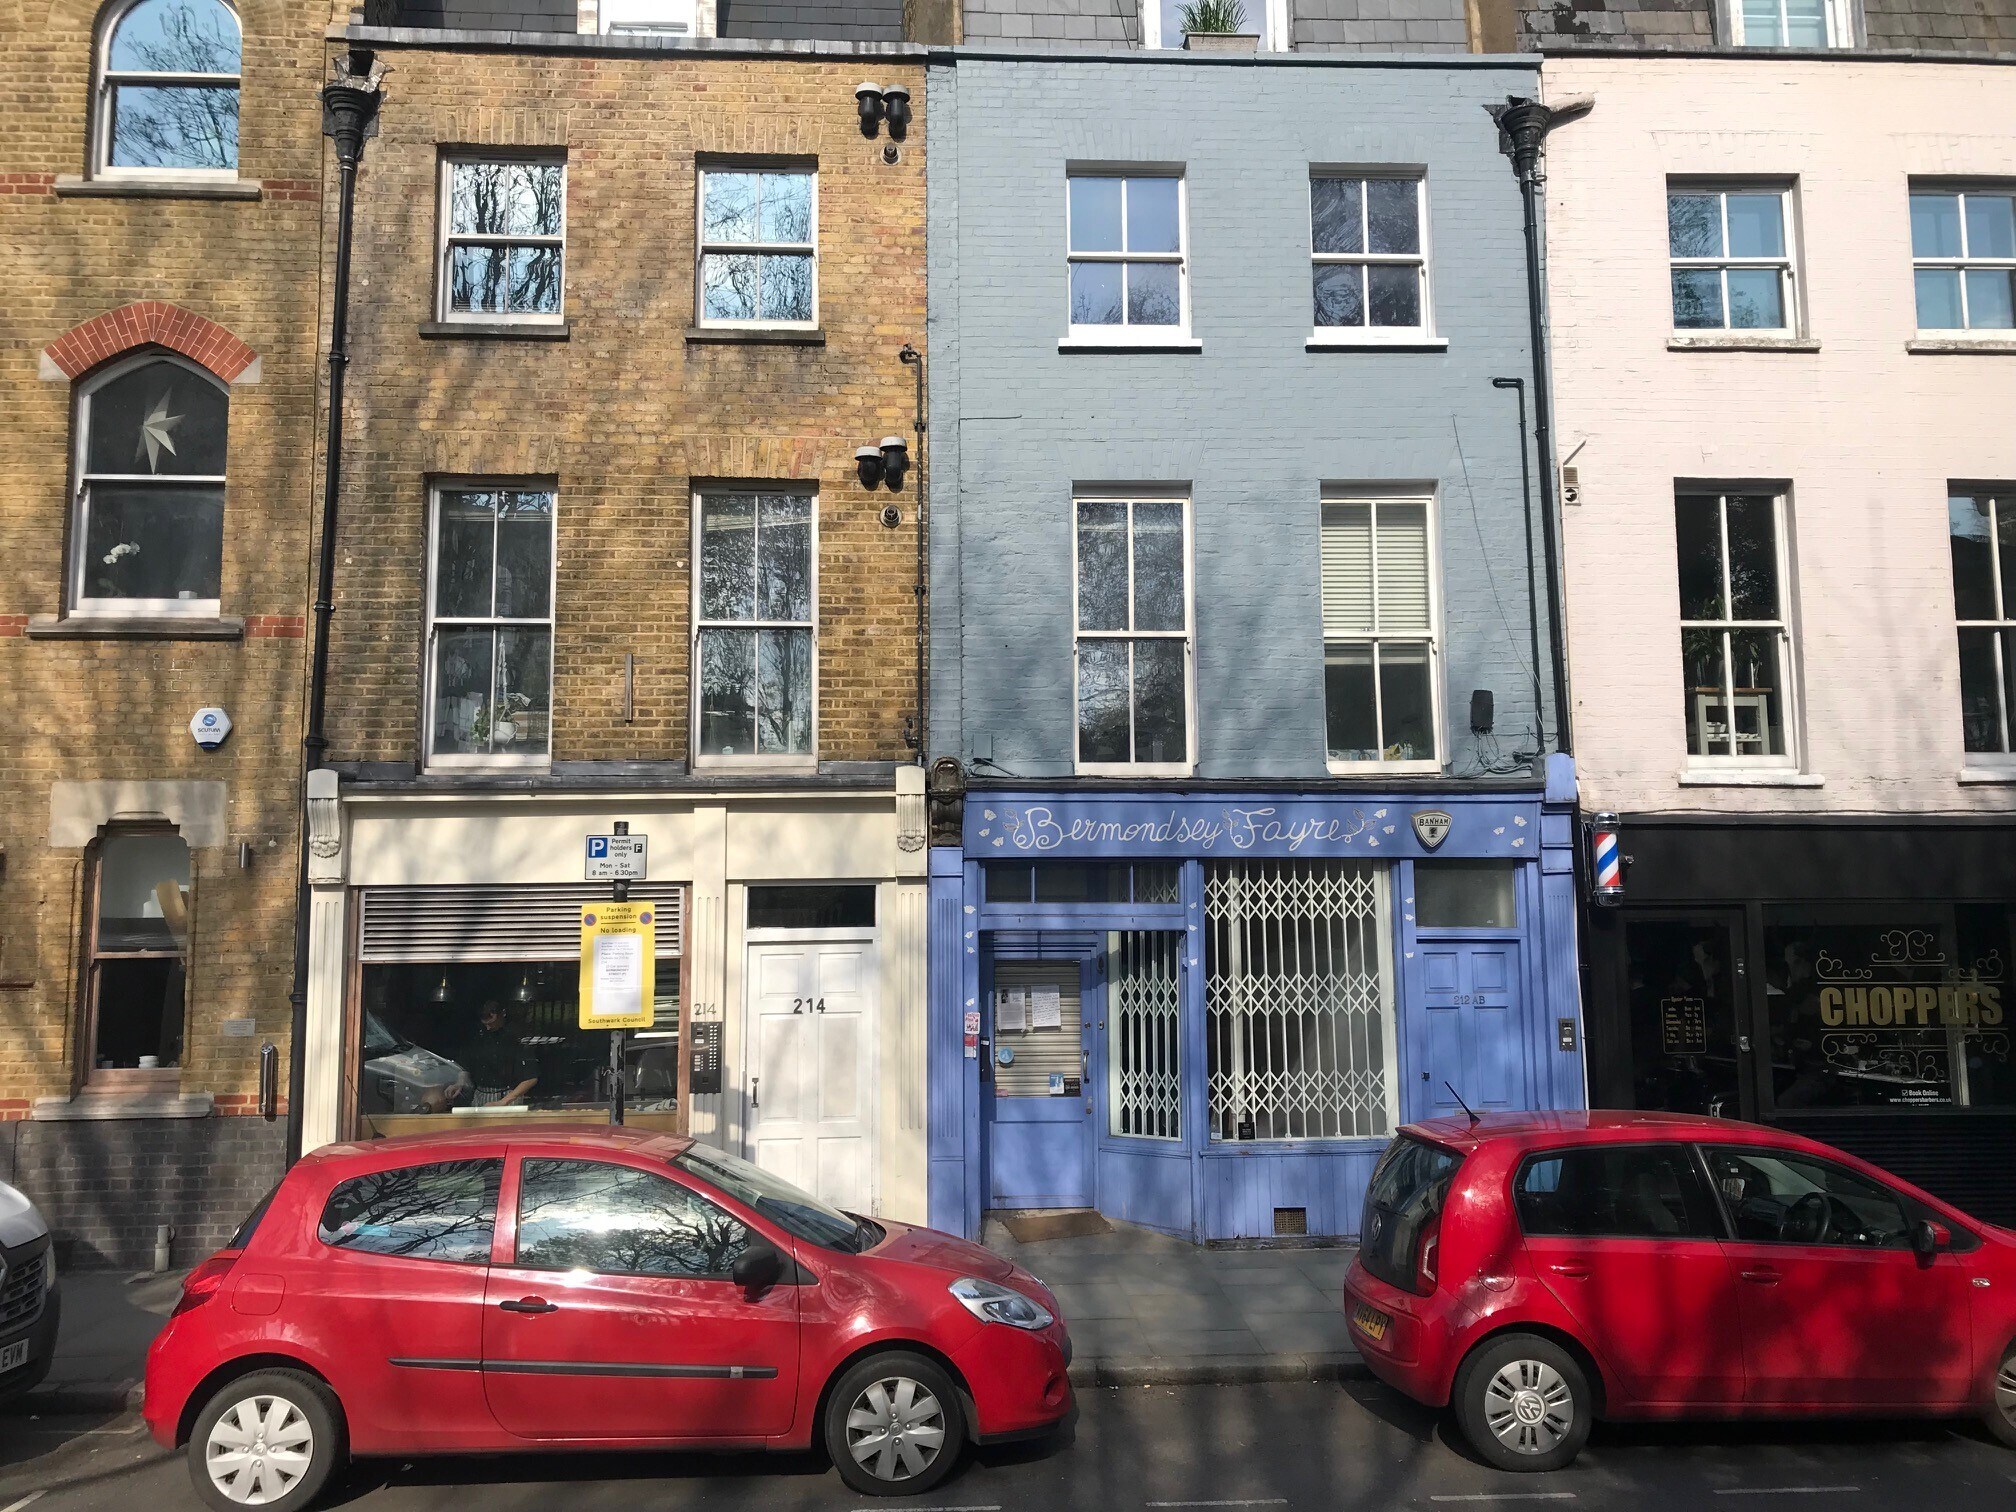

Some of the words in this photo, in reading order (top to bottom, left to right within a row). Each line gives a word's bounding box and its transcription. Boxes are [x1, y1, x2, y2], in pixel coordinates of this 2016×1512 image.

[1012, 807, 1224, 850] Bermondsey
[1229, 807, 1343, 851] Fayre
[1419, 818, 1449, 827] BANHAM
[591, 839, 605, 857] P
[635, 844, 642, 853] F
[793, 998, 826, 1014] 214
[1453, 995, 1470, 1005] 212
[1471, 995, 1486, 1005] AB
[1819, 986, 2004, 1026] CHOPPERS
[693, 1003, 717, 1016] 214
[1908, 1089, 1922, 1097] Book
[1922, 1089, 1939, 1097] Online
